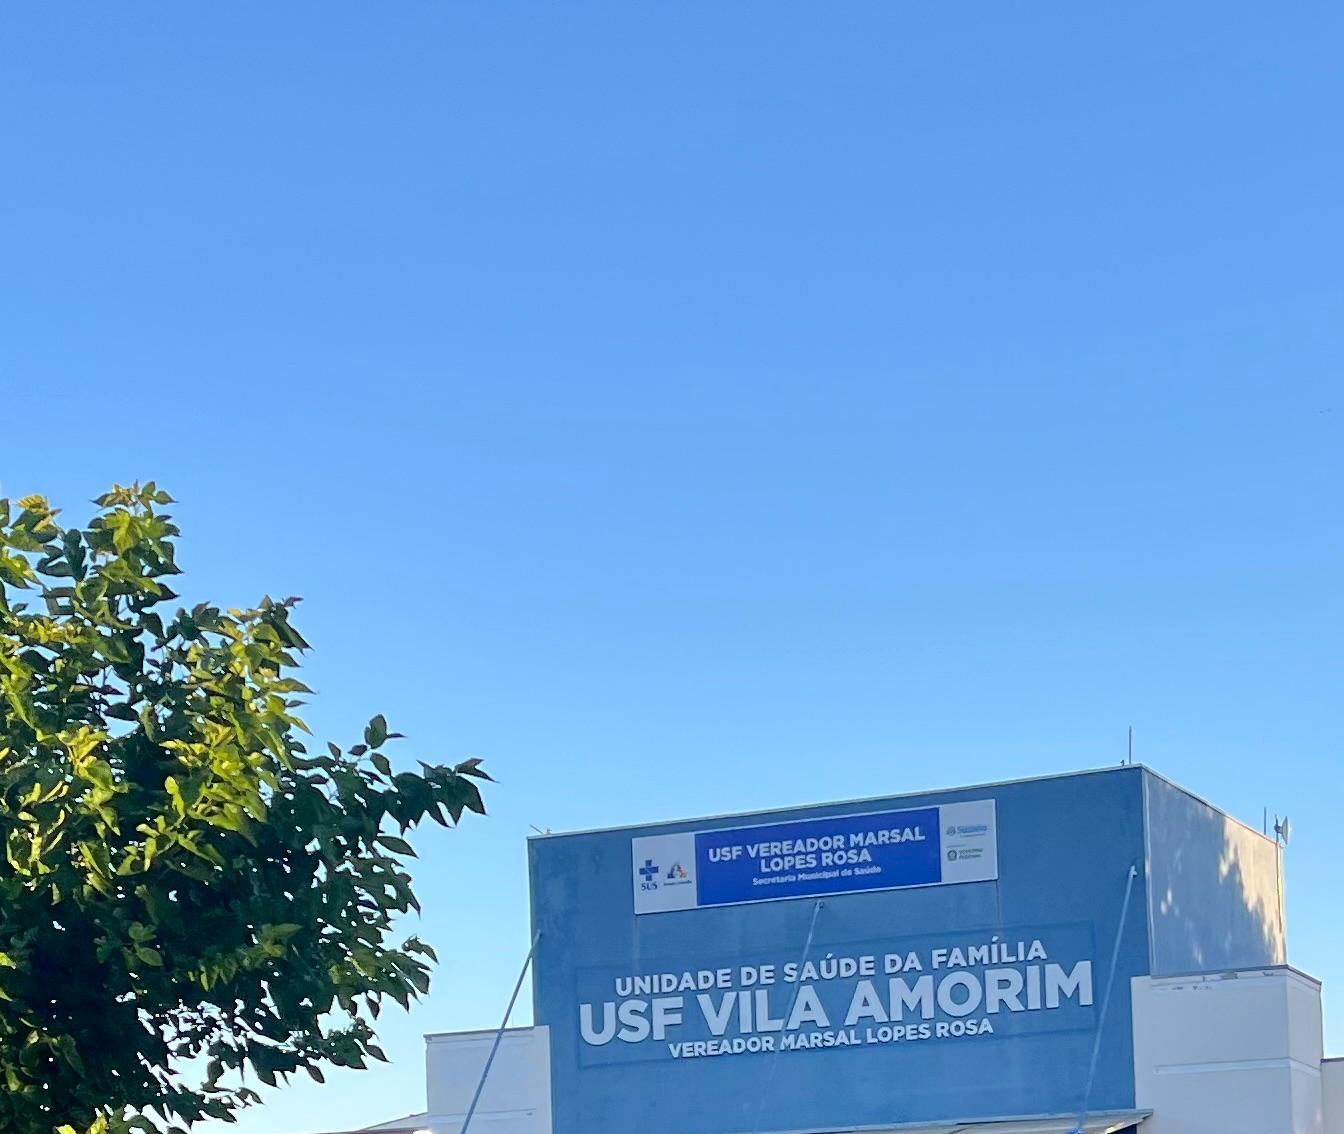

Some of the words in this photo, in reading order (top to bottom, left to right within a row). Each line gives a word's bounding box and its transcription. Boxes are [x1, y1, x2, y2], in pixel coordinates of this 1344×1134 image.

[708, 846, 742, 862] USF
[746, 835, 845, 858] VEREADOR
[849, 826, 926, 847] MARSAL
[760, 853, 817, 873] LOPES
[821, 848, 872, 867] ROSA
[752, 875, 796, 886] Secretaria
[797, 869, 840, 881] Municipal
[840, 869, 853, 877] de
[854, 866, 882, 876] Saúde
[615, 968, 732, 997] UNIDADE
[740, 964, 776, 987] DE
[783, 953, 875, 983] SAÚDE
[884, 951, 923, 974] DA
[931, 935, 1048, 969] FAMÍLIA
[579, 996, 684, 1046] USF
[696, 984, 831, 1036] VILA
[843, 960, 1094, 1026] AMORIM
[668, 1035, 774, 1059] VEREADOR
[780, 1029, 862, 1051] MARSAL
[866, 1023, 931, 1044] LOPES
[935, 1018, 994, 1038] ROSA
